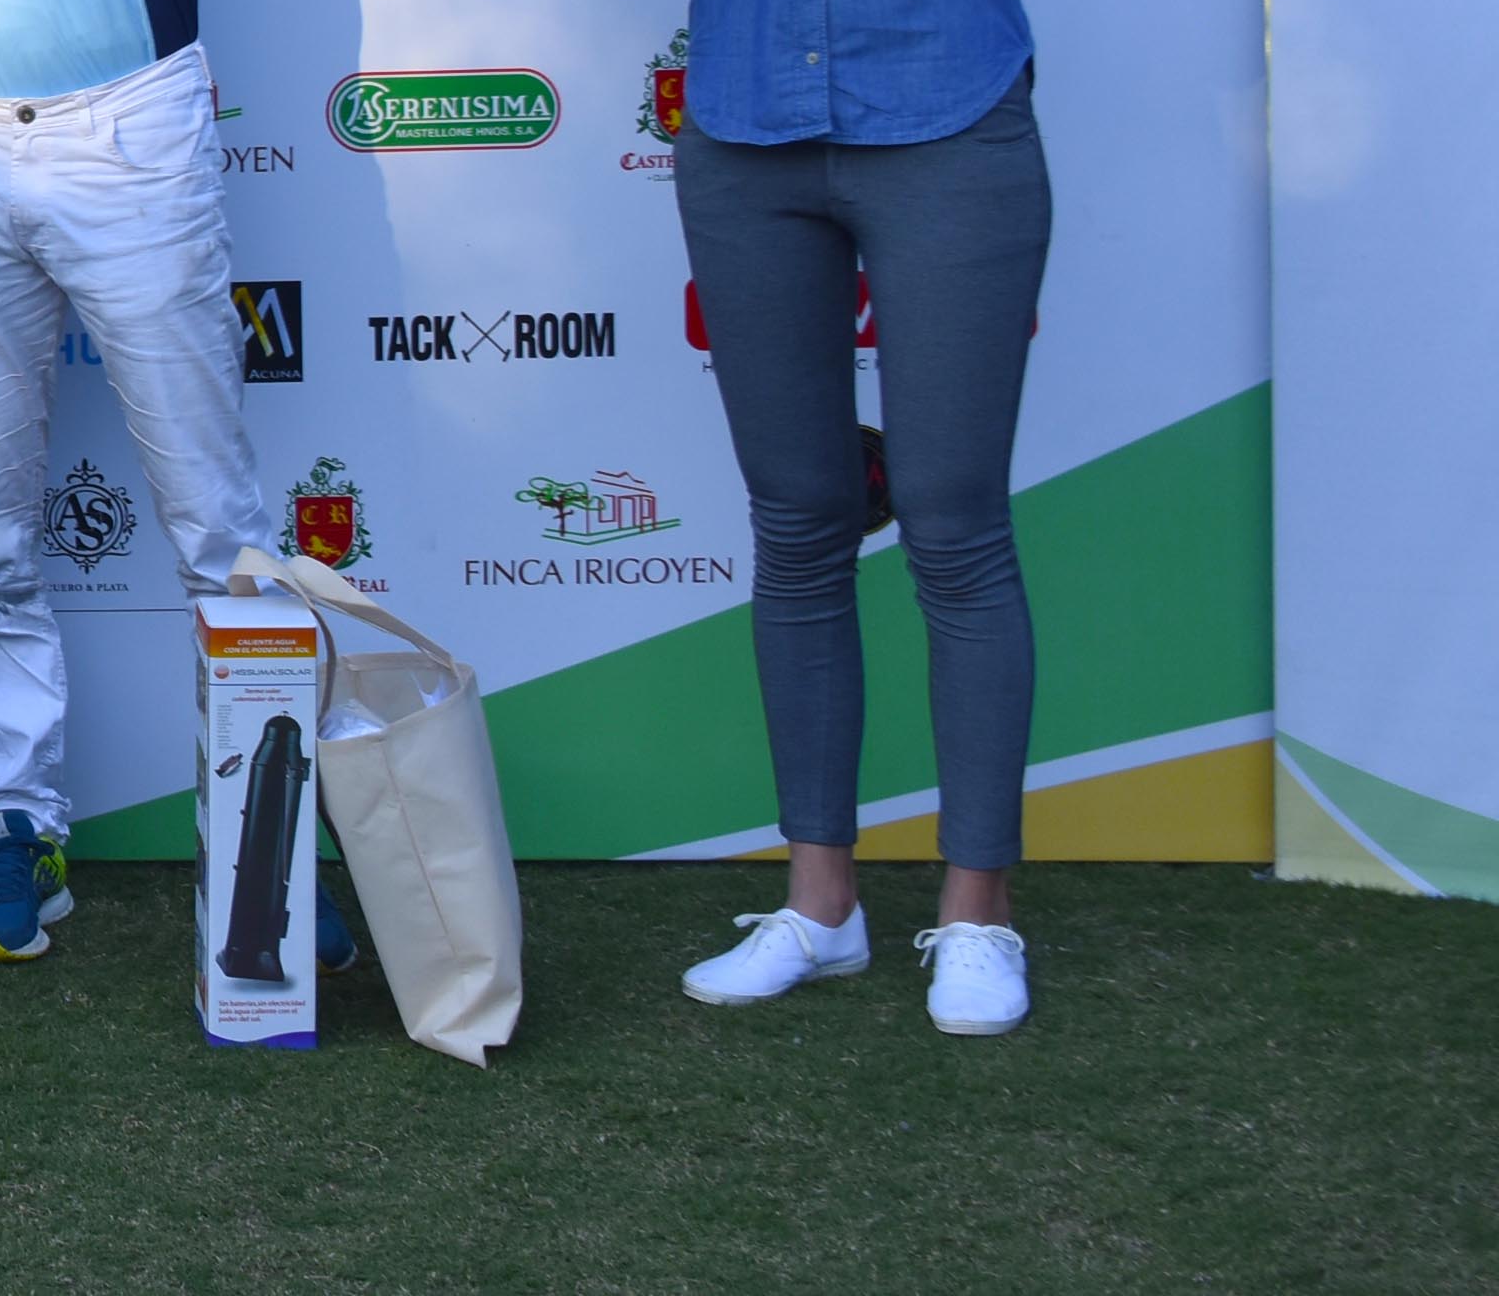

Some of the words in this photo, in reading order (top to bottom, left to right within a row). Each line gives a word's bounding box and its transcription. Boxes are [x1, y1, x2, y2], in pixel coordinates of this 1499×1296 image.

[395, 127, 473, 138] MASTELLONE
[514, 126, 537, 136] S.A.
[620, 152, 675, 171] CASTE
[368, 315, 457, 361] TACK
[514, 312, 616, 359] ROOM
[464, 559, 563, 586] FINCA
[574, 557, 735, 586] IRIGOYEN
[50, 583, 82, 593] UERO
[85, 583, 94, 593] &
[97, 582, 129, 592] PLATA
